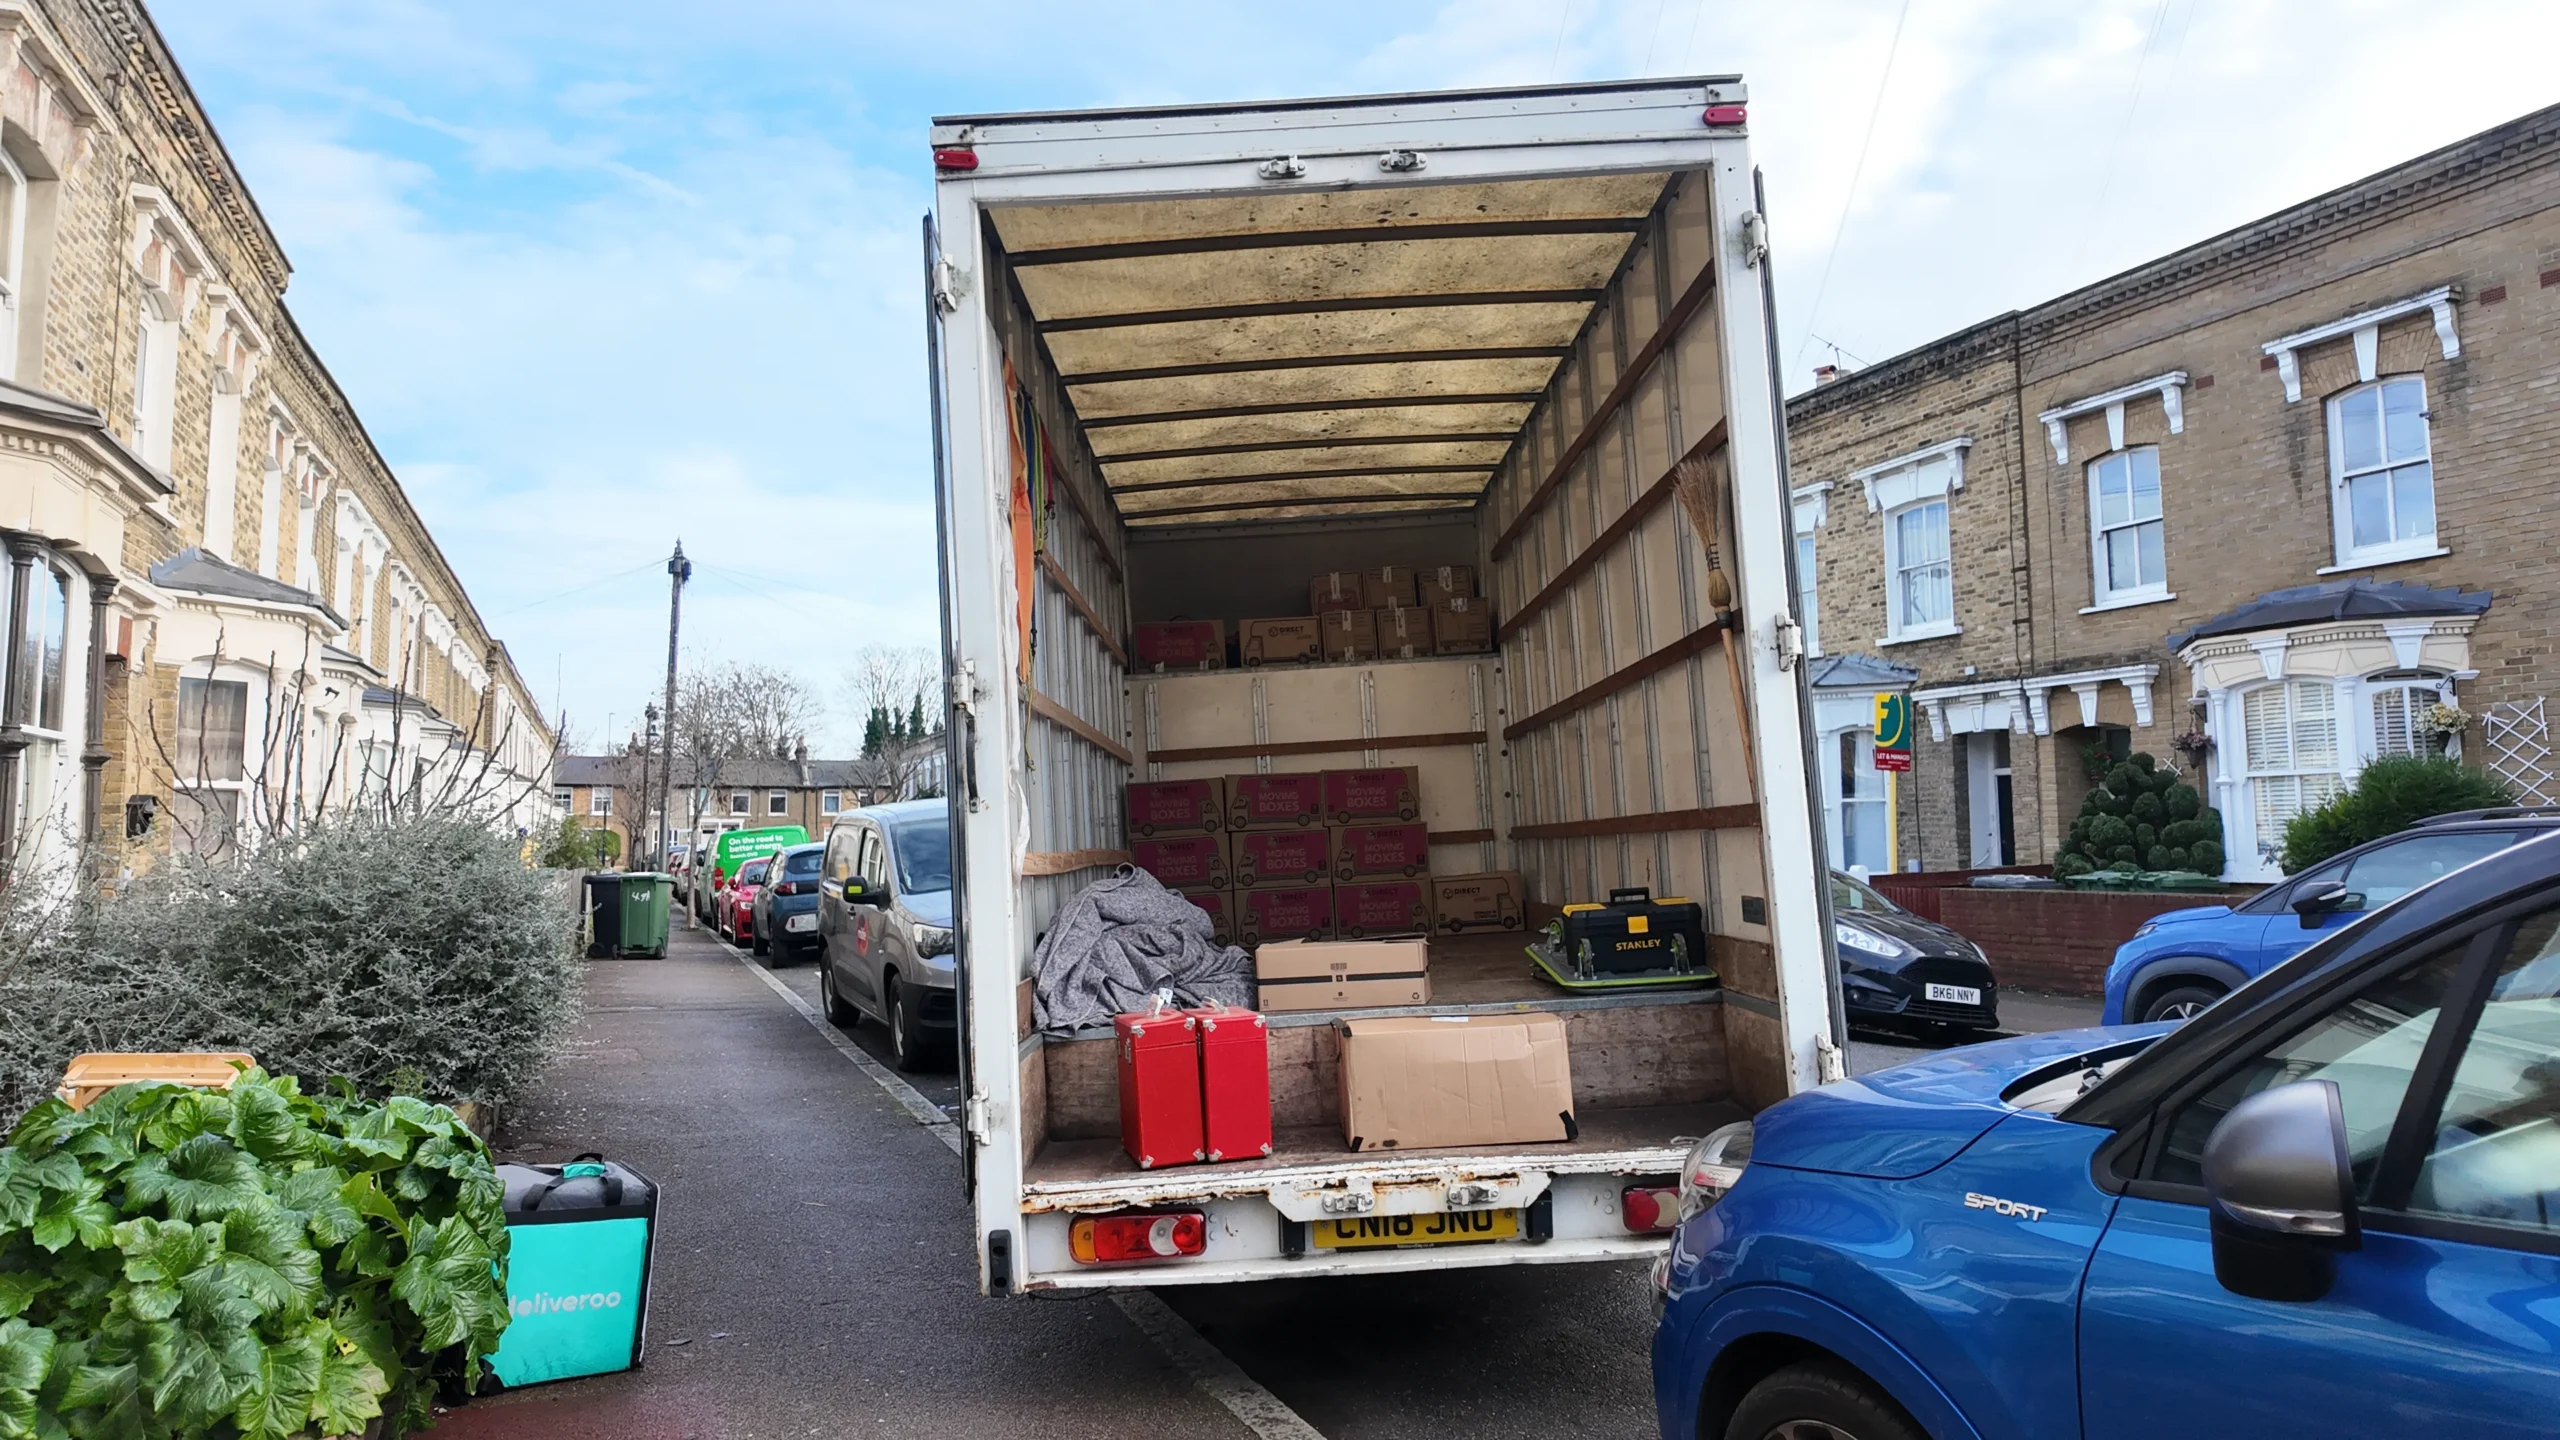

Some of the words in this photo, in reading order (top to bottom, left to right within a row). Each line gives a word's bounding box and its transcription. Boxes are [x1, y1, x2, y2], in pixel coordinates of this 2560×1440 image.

[1877, 752, 1886, 760] LET
[1258, 791, 1299, 801] MOVING
[1346, 786, 1387, 797] MOVING
[1259, 801, 1300, 812] BOXES
[1347, 796, 1388, 808] BOXES
[1150, 808, 1192, 820] BOXES
[728, 838, 741, 846] On
[742, 836, 755, 844] the
[756, 835, 774, 843] road
[775, 834, 784, 842] to
[729, 844, 753, 853] better
[1266, 848, 1307, 858] MOVING
[1364, 842, 1404, 853] MOVING
[1266, 858, 1307, 870] BOXES
[1365, 852, 1406, 864] BOXES
[1157, 865, 1199, 878] BOXES
[1454, 887, 1480, 895] DIRECT
[1268, 905, 1309, 916] MOVING
[1359, 901, 1400, 911] MOVING
[1269, 915, 1310, 928] BOXES
[1360, 911, 1400, 923] BOXES
[1615, 938, 1662, 951] STANLEY
[1932, 986, 1955, 1000] BK61
[1957, 988, 1975, 1002] NNY
[1963, 1192, 2048, 1222] SPORT
